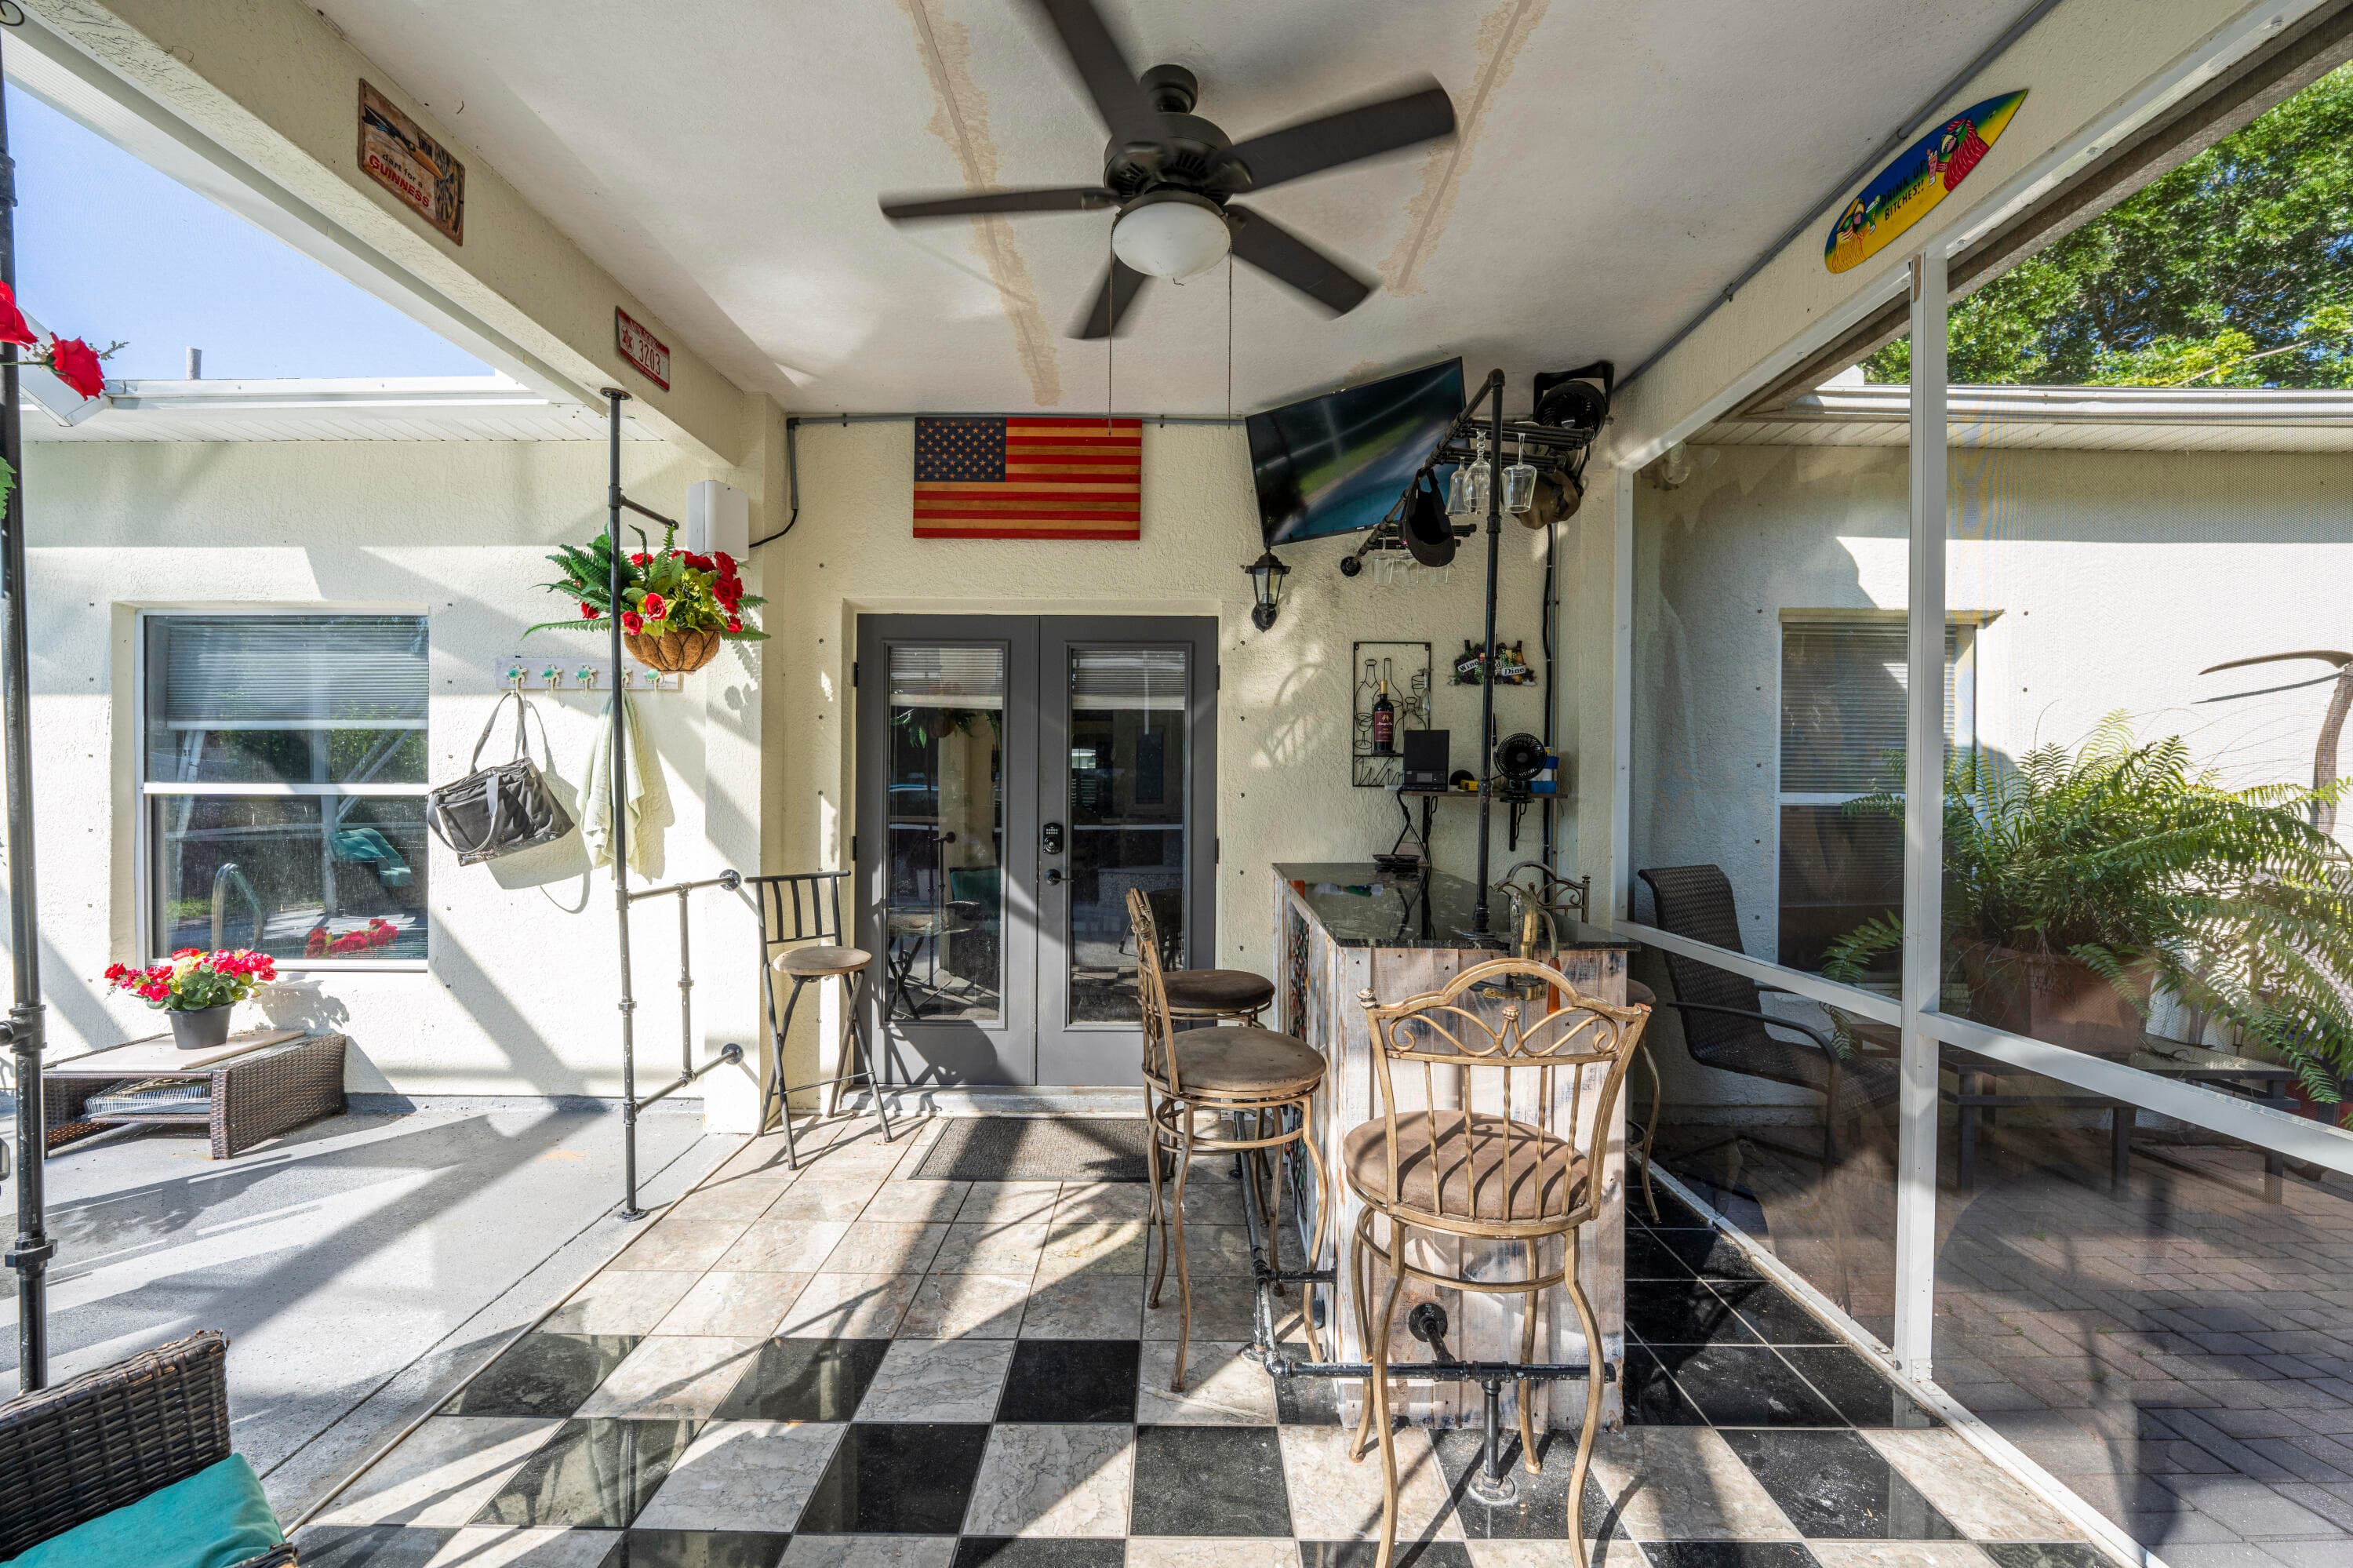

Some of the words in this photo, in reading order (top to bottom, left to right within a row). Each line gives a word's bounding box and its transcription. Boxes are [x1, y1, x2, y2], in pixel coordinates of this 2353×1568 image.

[369, 154, 430, 208] GUINNESS
[382, 153, 402, 172] dart
[404, 168, 416, 182] for
[1881, 172, 1910, 209] DRINK
[1913, 158, 1927, 179] UP
[1885, 178, 1925, 221] BITCHES!!
[638, 339, 660, 376] 3203
[1459, 660, 1479, 672] Wine
[1504, 666, 1526, 675] Dine
[1355, 755, 1404, 785] Win
